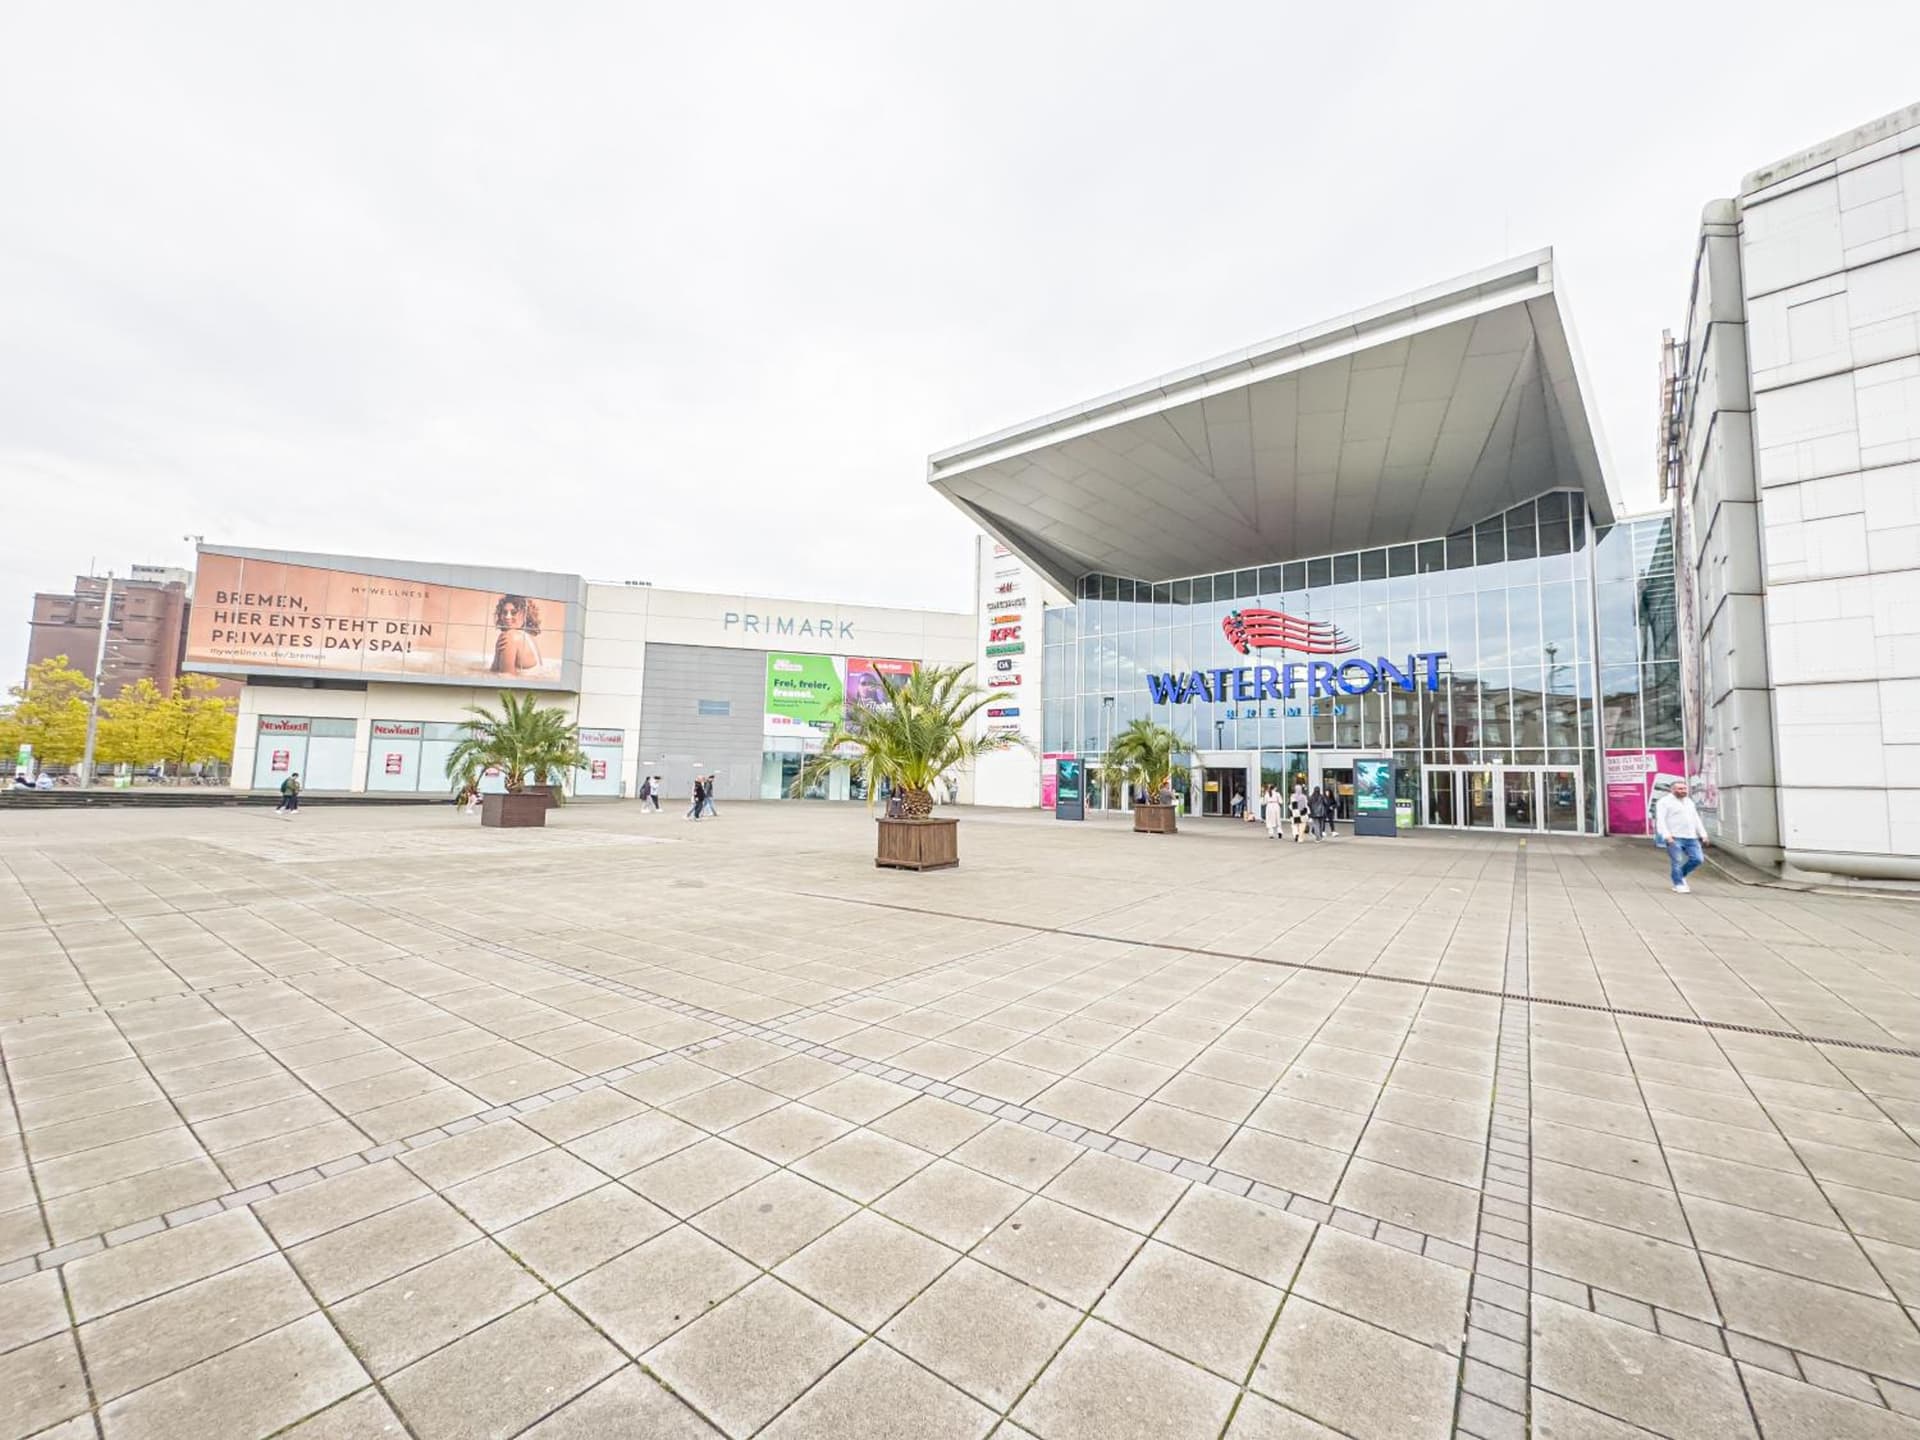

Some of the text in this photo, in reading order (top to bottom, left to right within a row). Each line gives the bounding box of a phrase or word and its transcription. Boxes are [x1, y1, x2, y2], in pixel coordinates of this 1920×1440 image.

[215, 590, 308, 612] BREMEN,
[214, 611, 432, 636] HIER ENTSTEHT DEIN
[724, 611, 855, 640] PRIMARK
[211, 629, 412, 653] PRIVATES DAY SPA!
[773, 678, 831, 692] Frei, freier,
[1146, 652, 1448, 704] WATERFRONT
